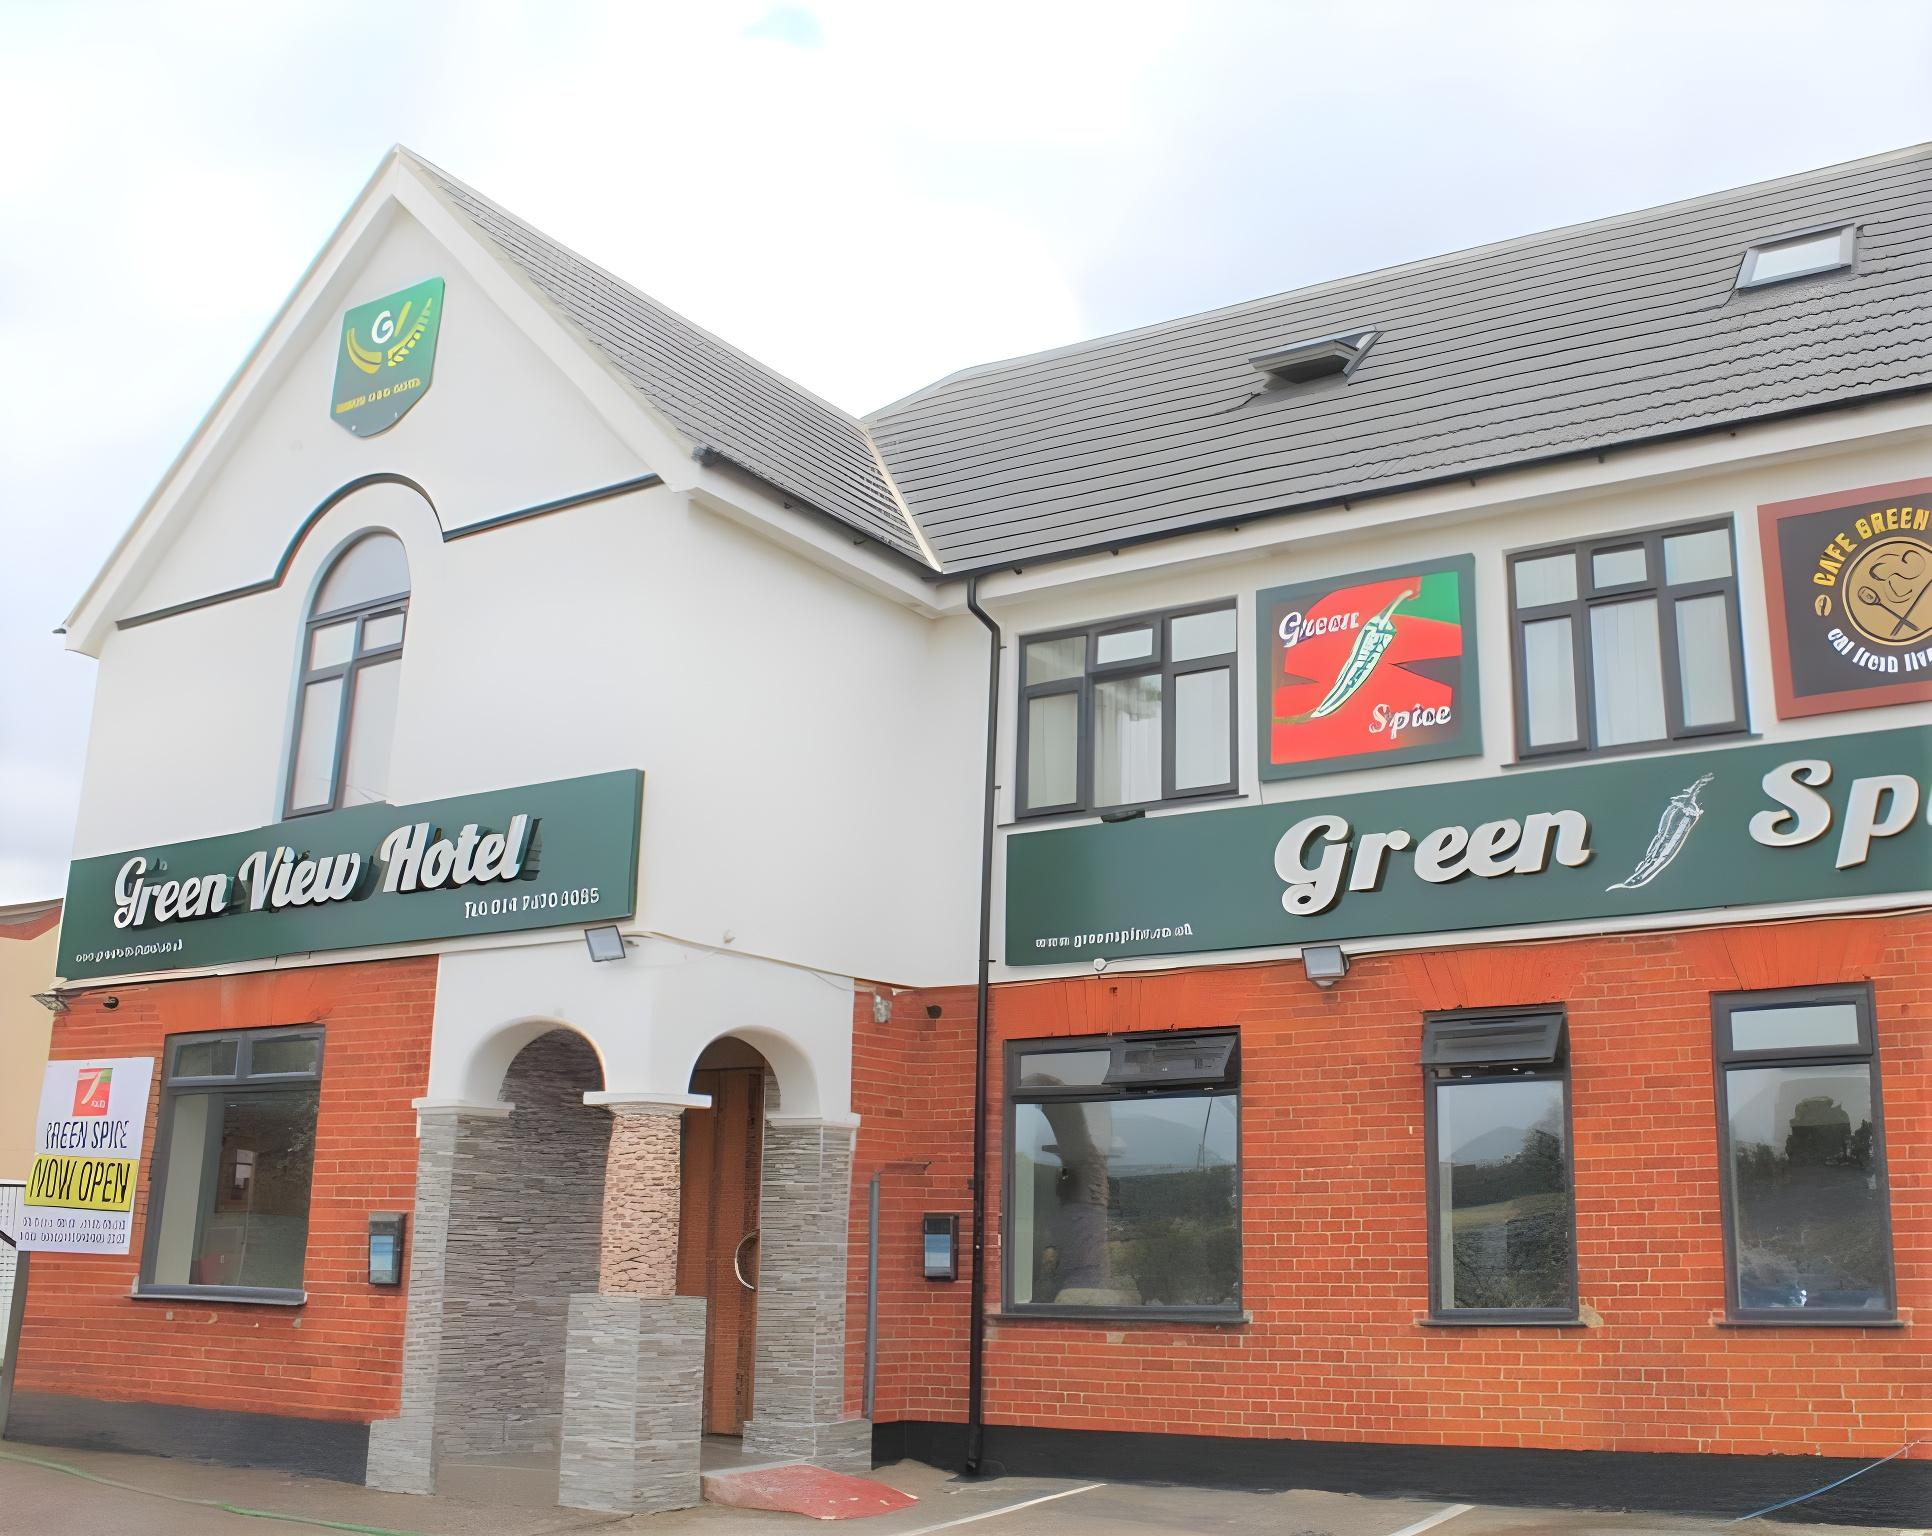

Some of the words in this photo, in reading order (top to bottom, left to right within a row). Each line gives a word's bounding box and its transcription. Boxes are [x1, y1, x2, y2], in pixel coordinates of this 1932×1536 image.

[1813, 532, 1858, 587] CAFE
[1855, 507, 1930, 540] GREEN
[1278, 611, 1360, 648] Green
[1368, 703, 1452, 740] Spice
[1274, 809, 1592, 916] Green
[1748, 759, 1932, 869] Sp
[113, 856, 228, 929] Green
[238, 846, 361, 912] View
[379, 813, 530, 894] Hotel
[29, 1158, 77, 1200] NOW
[78, 1161, 131, 1204] OPEN
